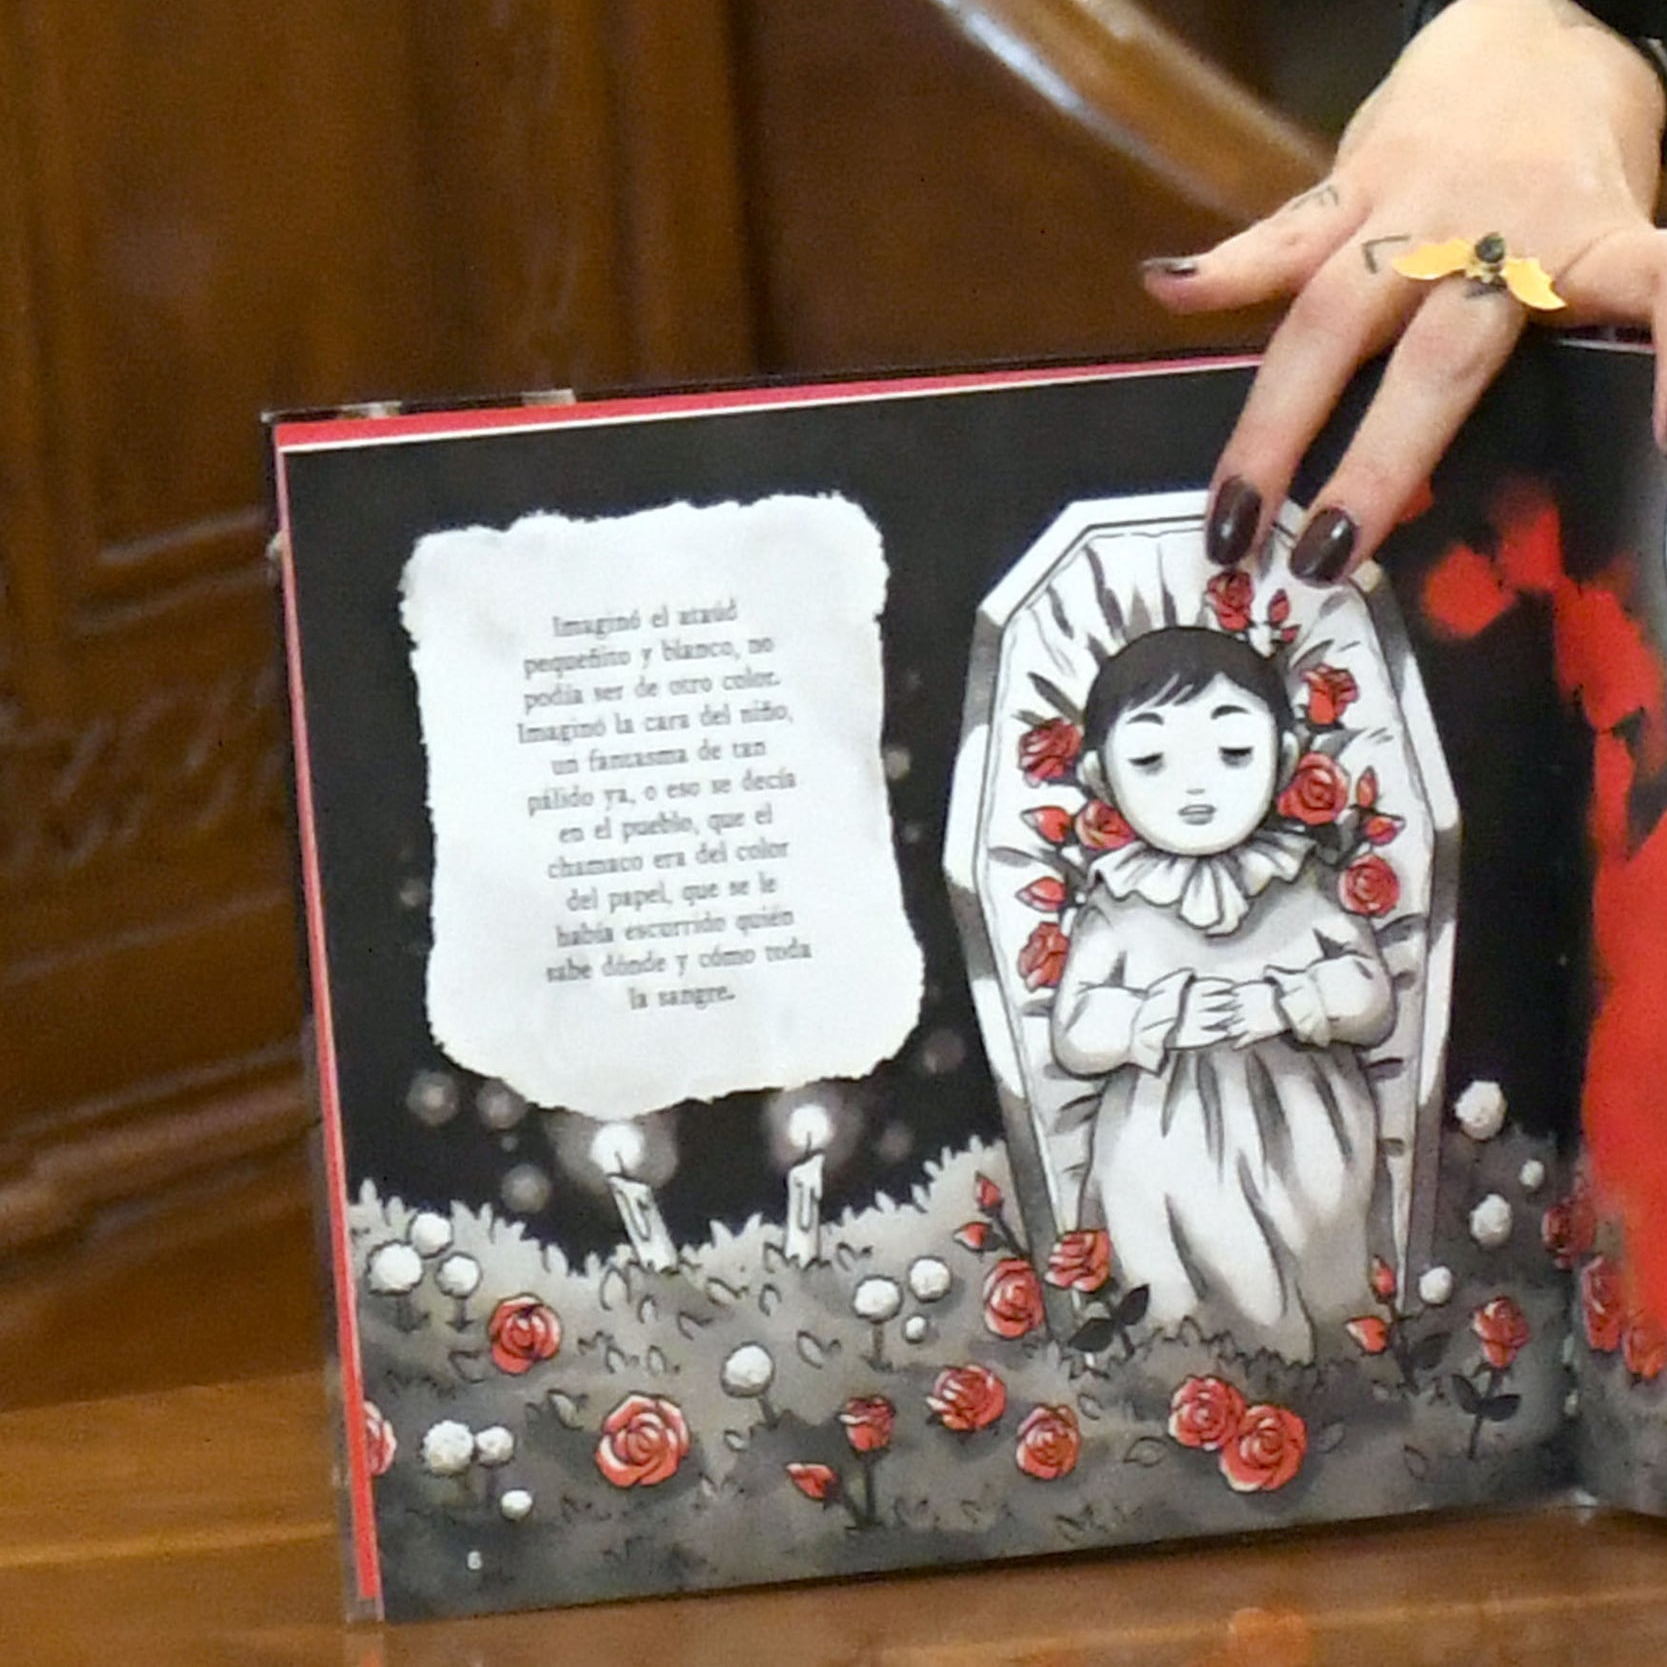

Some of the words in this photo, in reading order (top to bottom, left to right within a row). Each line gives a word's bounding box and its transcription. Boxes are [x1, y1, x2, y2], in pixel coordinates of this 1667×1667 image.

[553, 609, 641, 640] Imaginó
[650, 604, 668, 629] el
[678, 597, 737, 626] ataúd
[524, 645, 630, 680] pequeñito
[641, 647, 652, 669] y
[661, 638, 740, 662] blanco,
[748, 637, 774, 654] no
[524, 683, 584, 716] podía
[594, 685, 623, 702] ser
[634, 675, 659, 698] de
[668, 676, 712, 696] otro
[722, 665, 780, 691] color.
[517, 717, 606, 746] Imaginó
[614, 712, 634, 735] la
[643, 714, 689, 732] cara
[699, 703, 730, 727] del
[740, 700, 793, 724] niño,
[551, 758, 579, 776] un
[588, 748, 688, 772] fantasma
[697, 738, 721, 761] de
[732, 741, 766, 759] tan
[528, 784, 594, 818] pálido
[603, 788, 636, 811] ya,
[643, 785, 657, 801] o
[666, 781, 700, 799] eso
[710, 778, 731, 795] se
[742, 767, 796, 792] decía
[559, 827, 584, 844] en
[594, 816, 611, 840] el
[621, 810, 699, 844] pueblo,
[707, 812, 744, 835] que
[755, 802, 772, 825] el
[548, 855, 643, 879] chamaco
[653, 851, 686, 869] era
[695, 840, 727, 865] del
[736, 836, 789, 862] color
[566, 886, 598, 912] del
[608, 880, 672, 914] papel,
[681, 882, 719, 907] que
[729, 880, 749, 897] se
[759, 871, 777, 894] le
[555, 921, 614, 948] había
[623, 910, 726, 941] escurrido
[736, 905, 794, 936] quién
[546, 956, 592, 983] sabe
[602, 950, 666, 977] dónde
[675, 953, 688, 976] y
[699, 944, 755, 968] cómo
[764, 936, 812, 962] toda
[628, 986, 648, 1010] la
[657, 985, 735, 1010] sangre.
